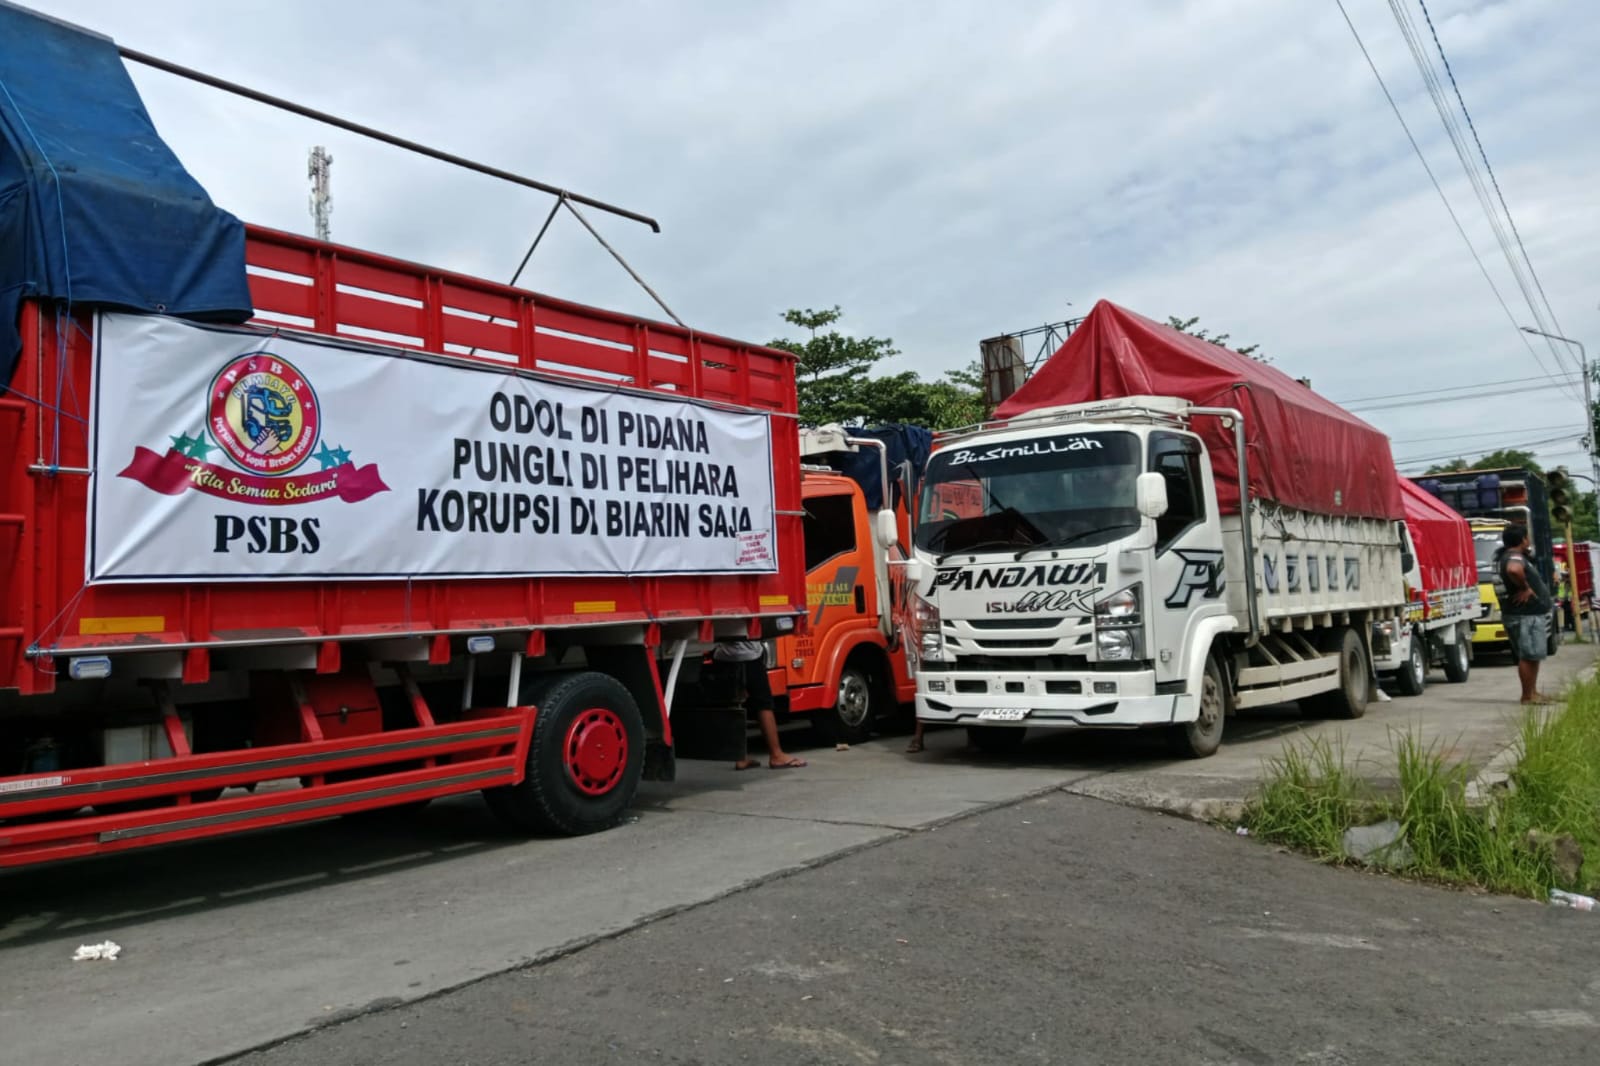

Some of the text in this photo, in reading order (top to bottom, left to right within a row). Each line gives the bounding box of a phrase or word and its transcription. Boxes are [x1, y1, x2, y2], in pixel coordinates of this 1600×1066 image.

[231, 372, 297, 405] BUMIAYU
[490, 391, 709, 455] ODOL DI PIDANA
[453, 438, 739, 498] PUNGLI DI PELIHARA
[227, 478, 281, 498] Semua
[417, 488, 753, 539] KORUPSI DI BIARIN SAJA
[213, 515, 320, 554] PSBS
[926, 562, 1108, 598] PANDAWA
